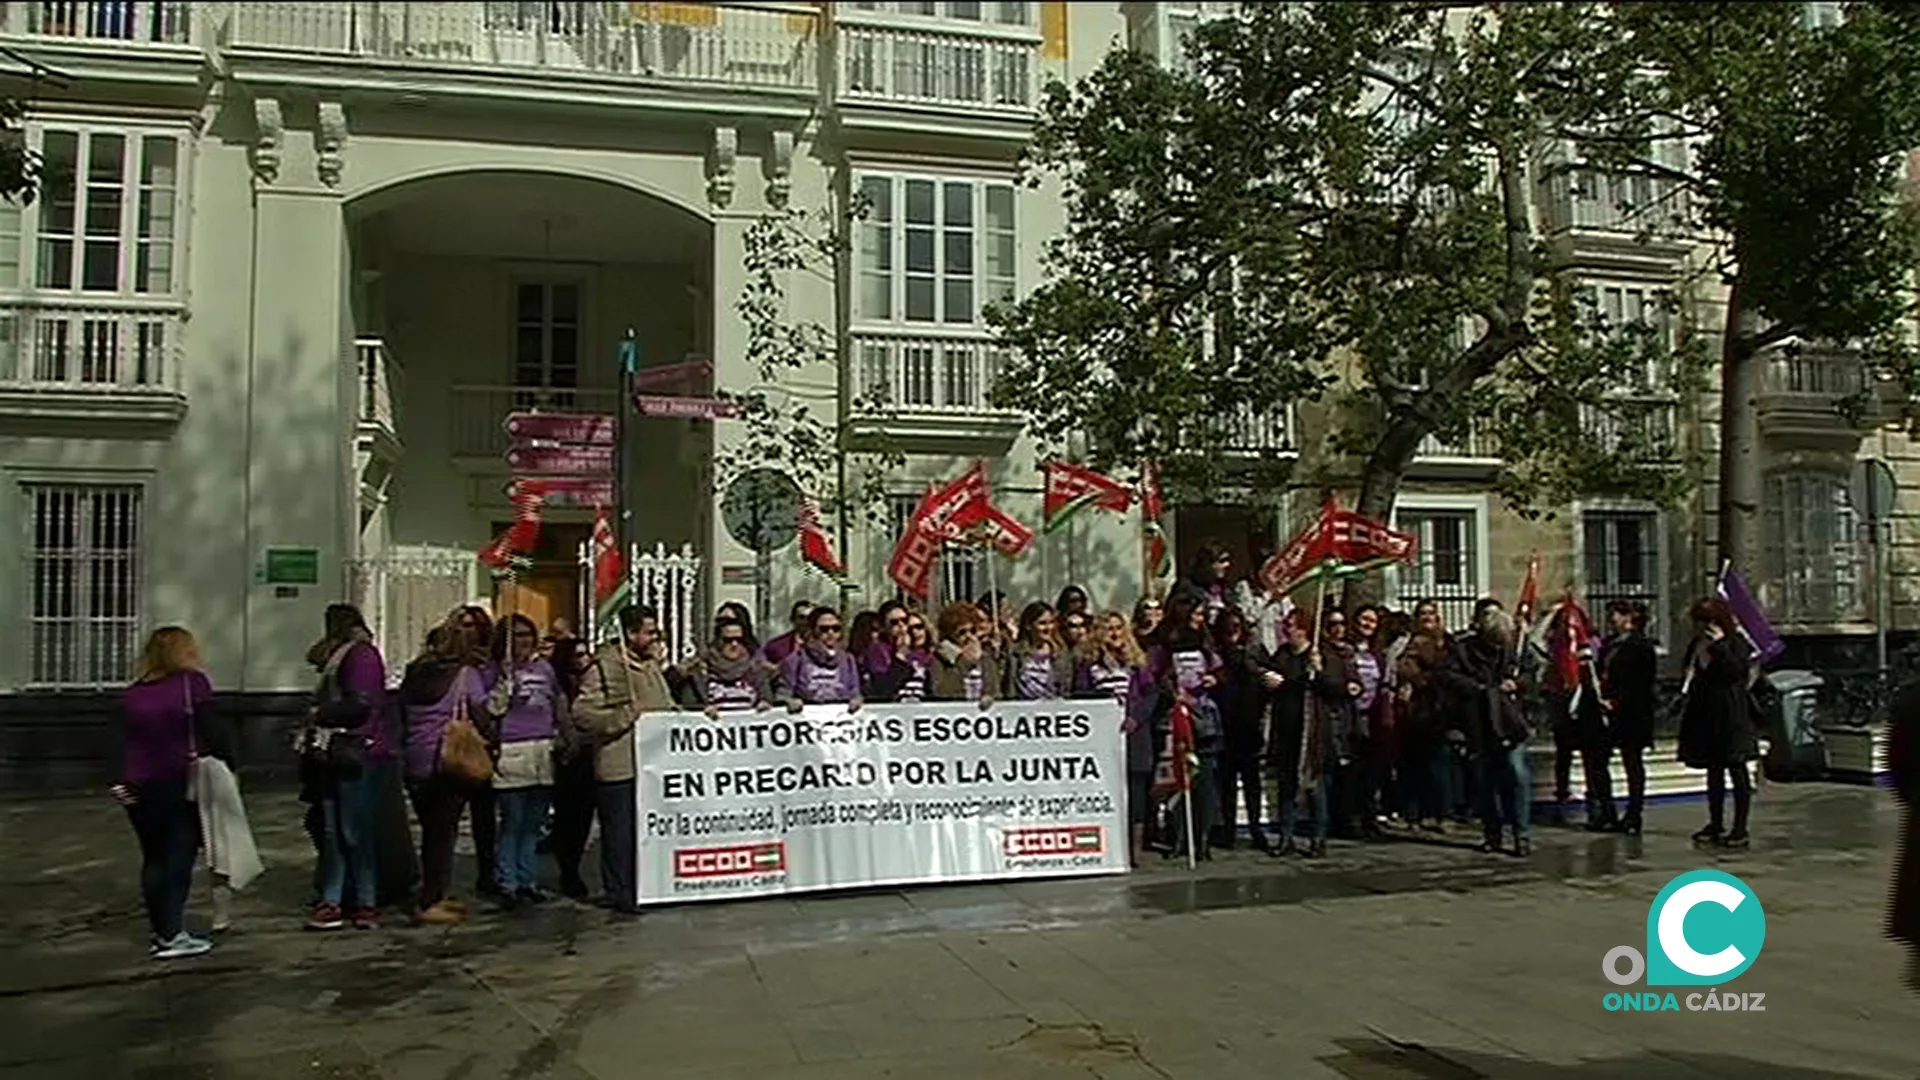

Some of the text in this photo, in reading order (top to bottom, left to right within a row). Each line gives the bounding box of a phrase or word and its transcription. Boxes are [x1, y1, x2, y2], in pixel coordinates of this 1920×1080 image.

[913, 713, 1091, 742] ESCOLARES
[662, 755, 1101, 798] EN PRECARIO POR LA JUNTA
[647, 811, 673, 837] Por
[677, 811, 690, 836] la
[693, 805, 779, 835] continuidad,
[780, 802, 836, 833] jornada
[838, 796, 900, 827] completa
[902, 802, 912, 825] y
[1007, 832, 1073, 852] CCOO
[678, 850, 751, 875] CCOO
